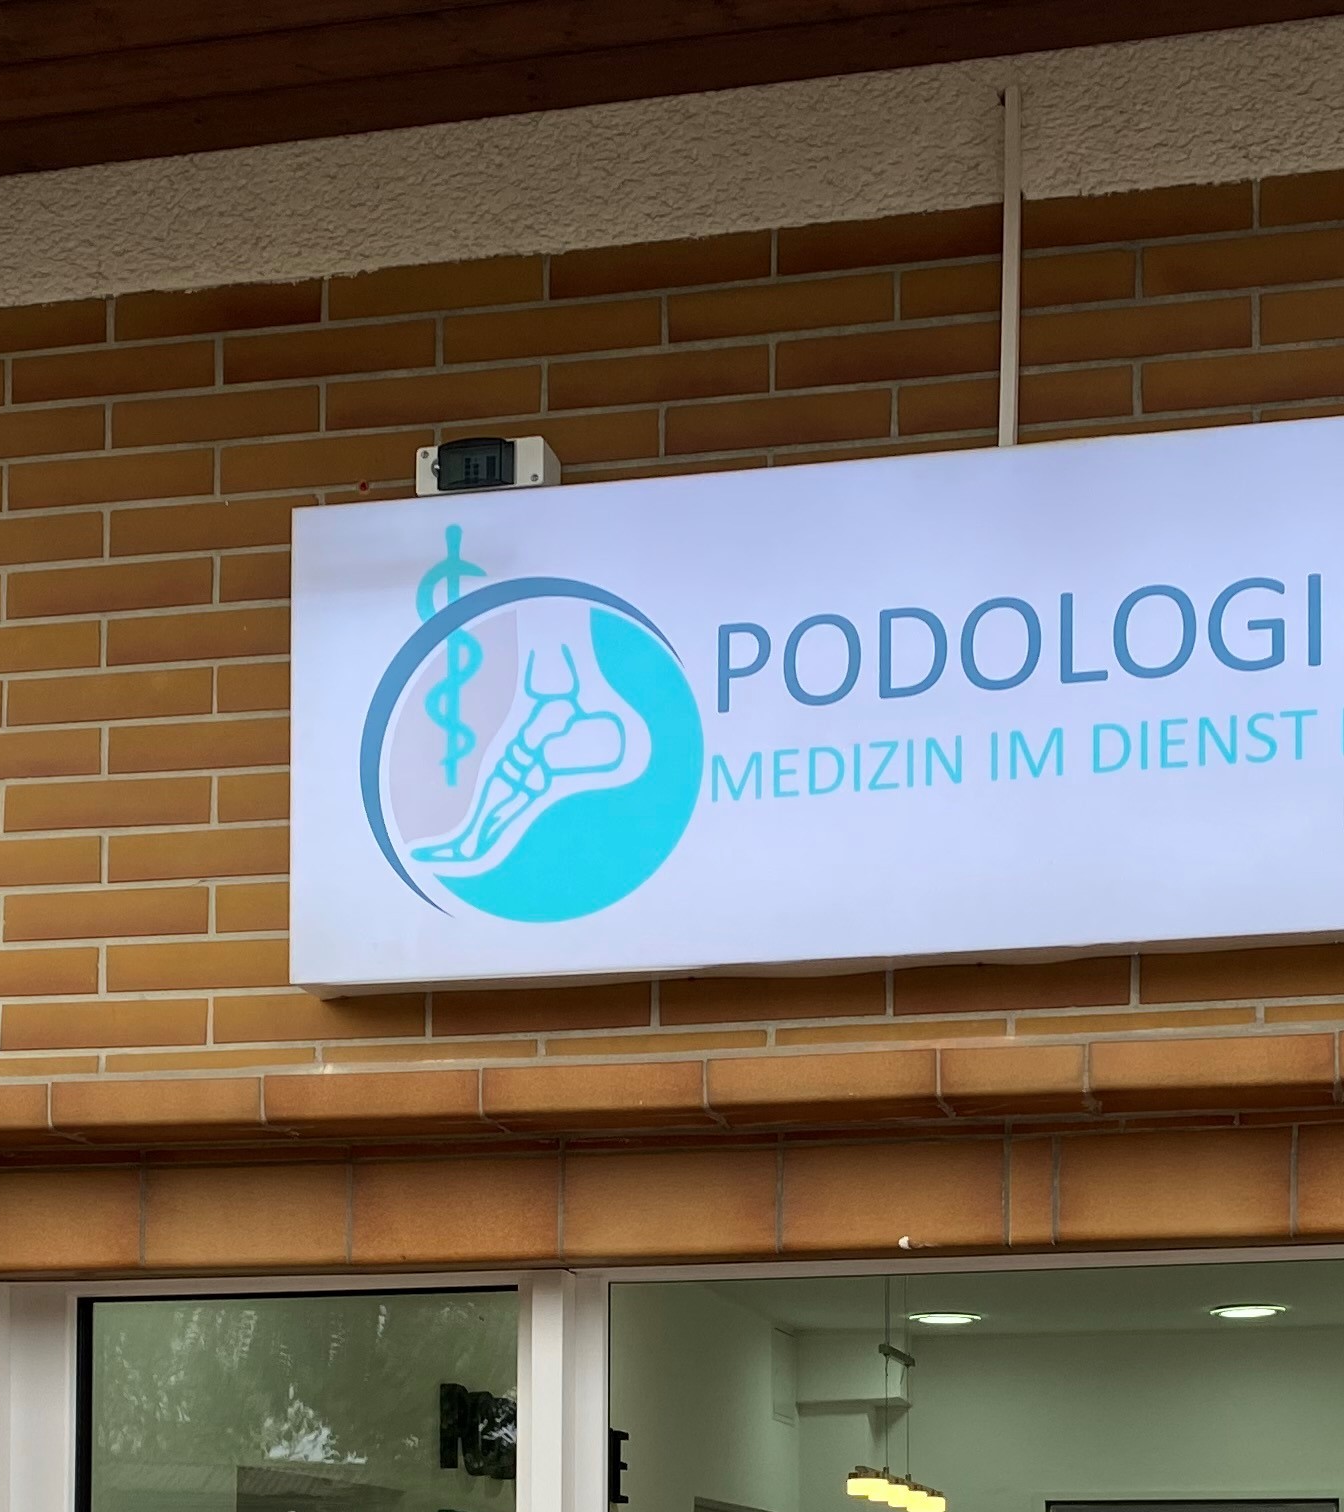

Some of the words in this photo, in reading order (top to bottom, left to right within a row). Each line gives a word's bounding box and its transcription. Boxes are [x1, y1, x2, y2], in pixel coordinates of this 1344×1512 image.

[710, 735, 967, 807] MEDIZIN
[986, 720, 1067, 785] IM
[1088, 704, 1323, 778] DIENST
